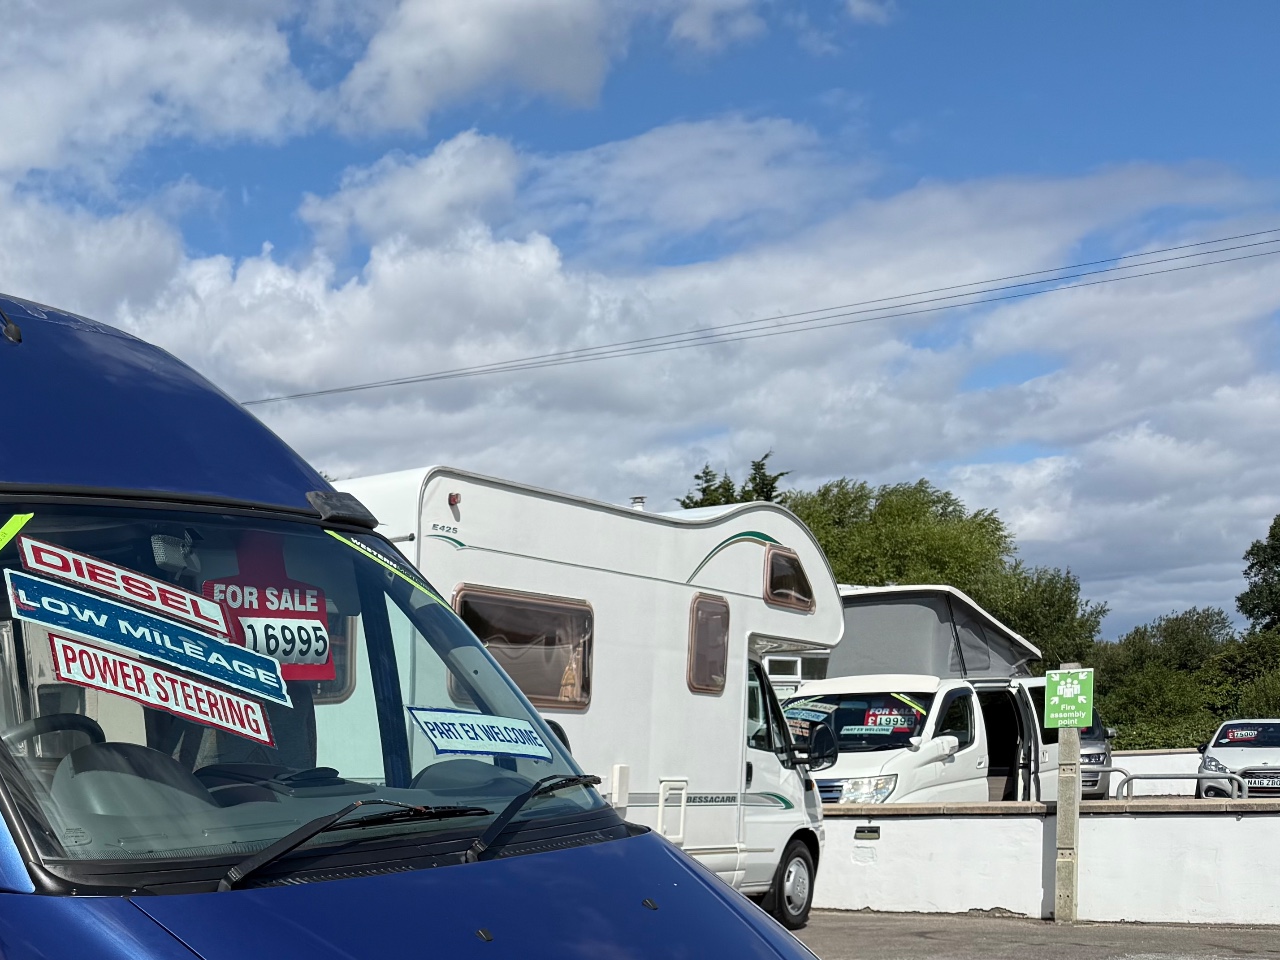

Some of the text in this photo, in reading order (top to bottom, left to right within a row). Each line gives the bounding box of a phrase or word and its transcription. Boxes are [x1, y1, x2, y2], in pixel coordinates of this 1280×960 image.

[432, 523, 458, 534] E425
[30, 544, 221, 626] DIESEL
[213, 583, 319, 612] FOR SALE
[18, 589, 280, 689] LOW MILEAGE
[247, 623, 328, 657] 16995
[61, 643, 262, 736] POWER STEERING
[1050, 711, 1087, 719] assembly
[1058, 719, 1078, 727] point
[423, 721, 544, 748] PART EX WELCOME
[686, 796, 737, 804] BESSACARR
